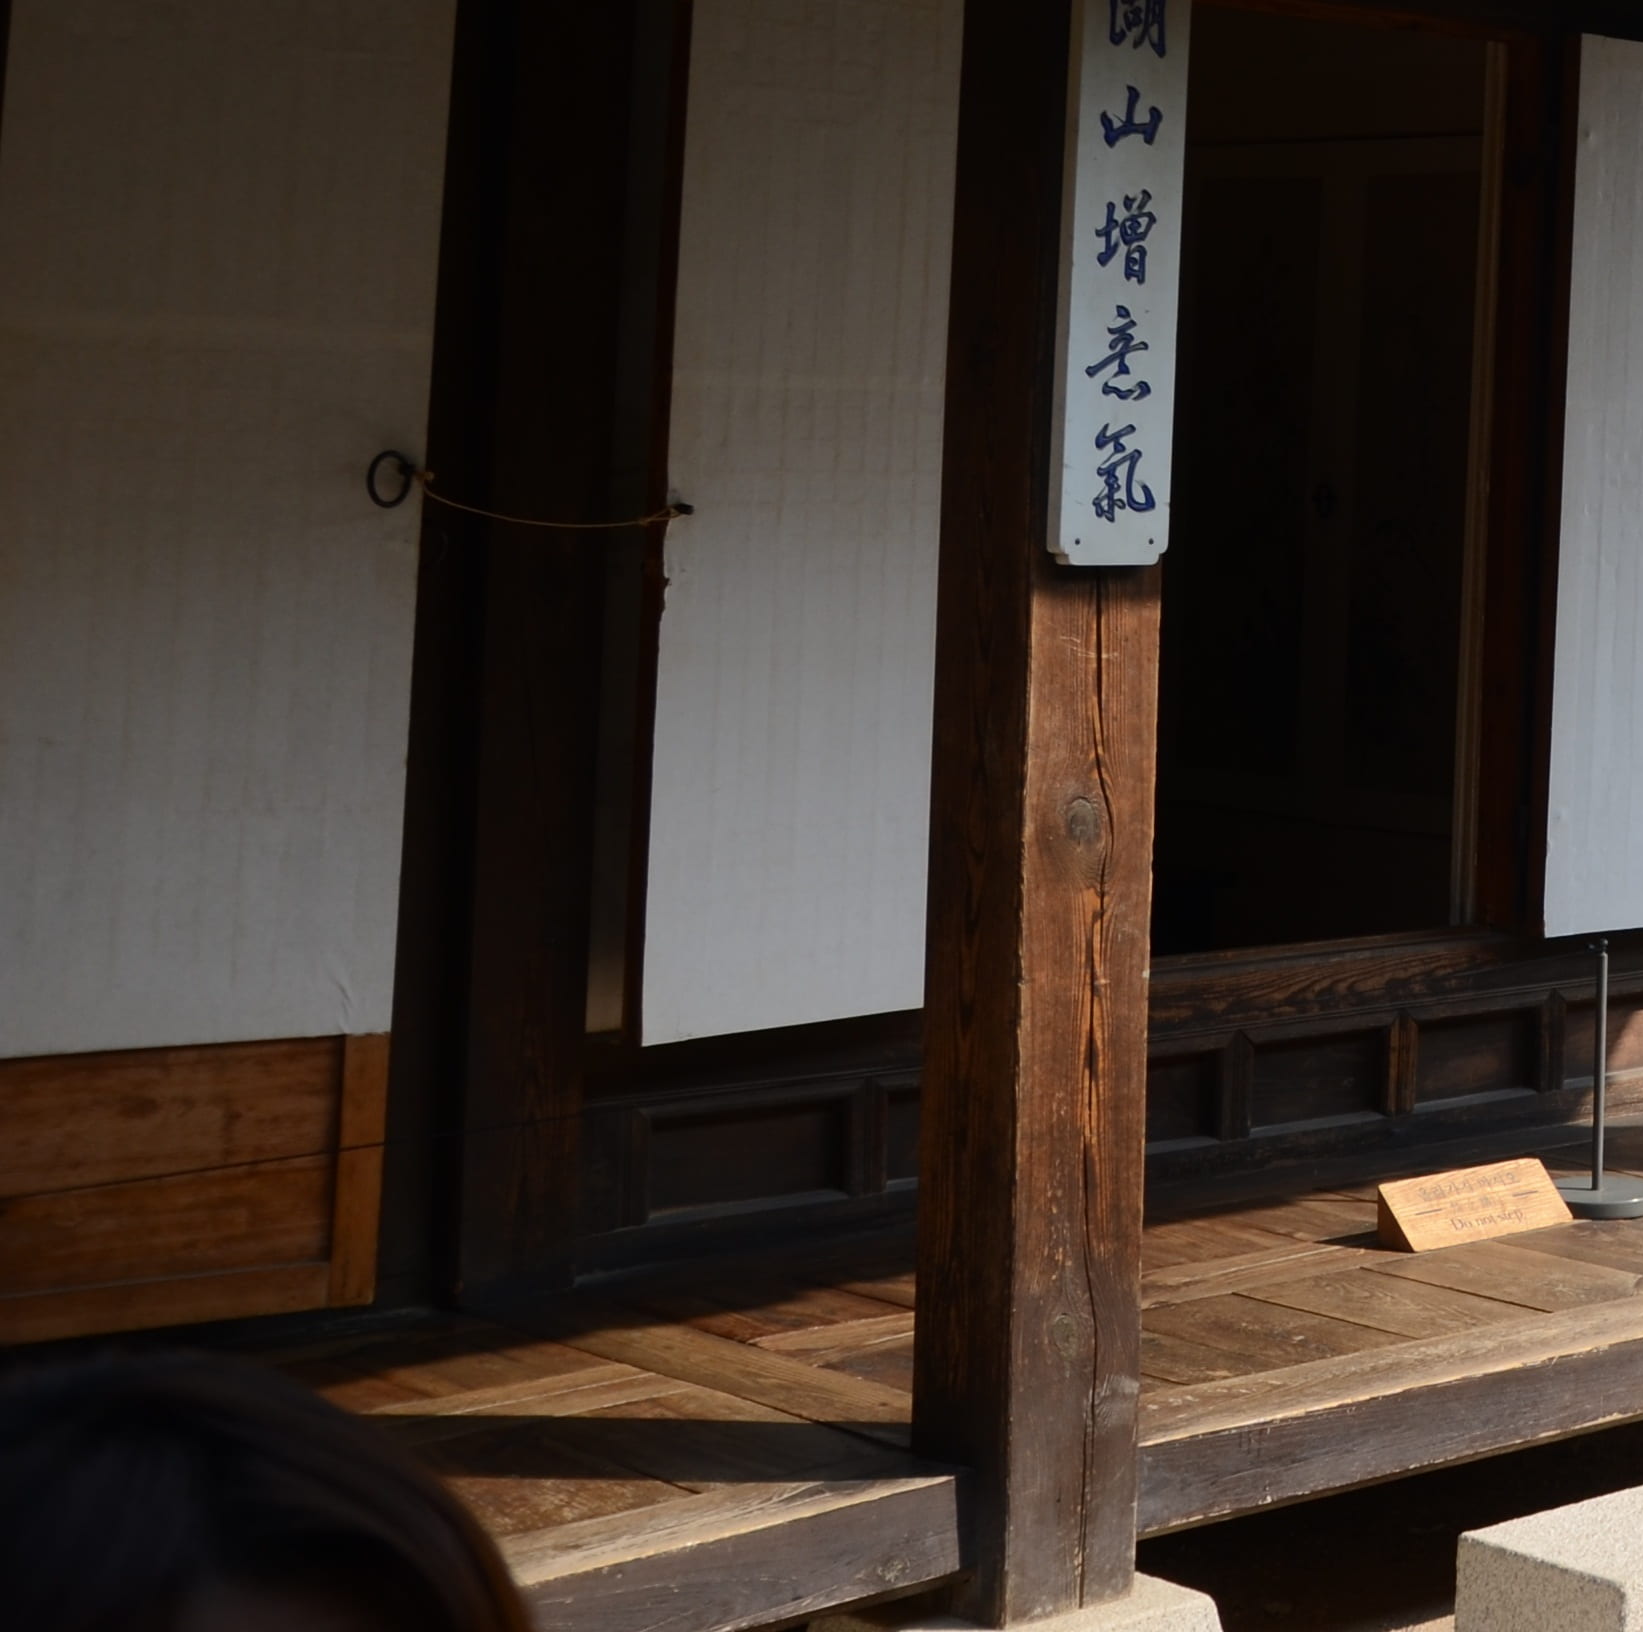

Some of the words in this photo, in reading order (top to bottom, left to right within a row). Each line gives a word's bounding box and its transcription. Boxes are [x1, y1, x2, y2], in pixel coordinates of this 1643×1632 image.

[1450, 1216, 1473, 1231] Do
[1475, 1214, 1497, 1227] not
[1497, 1209, 1524, 1225] step
